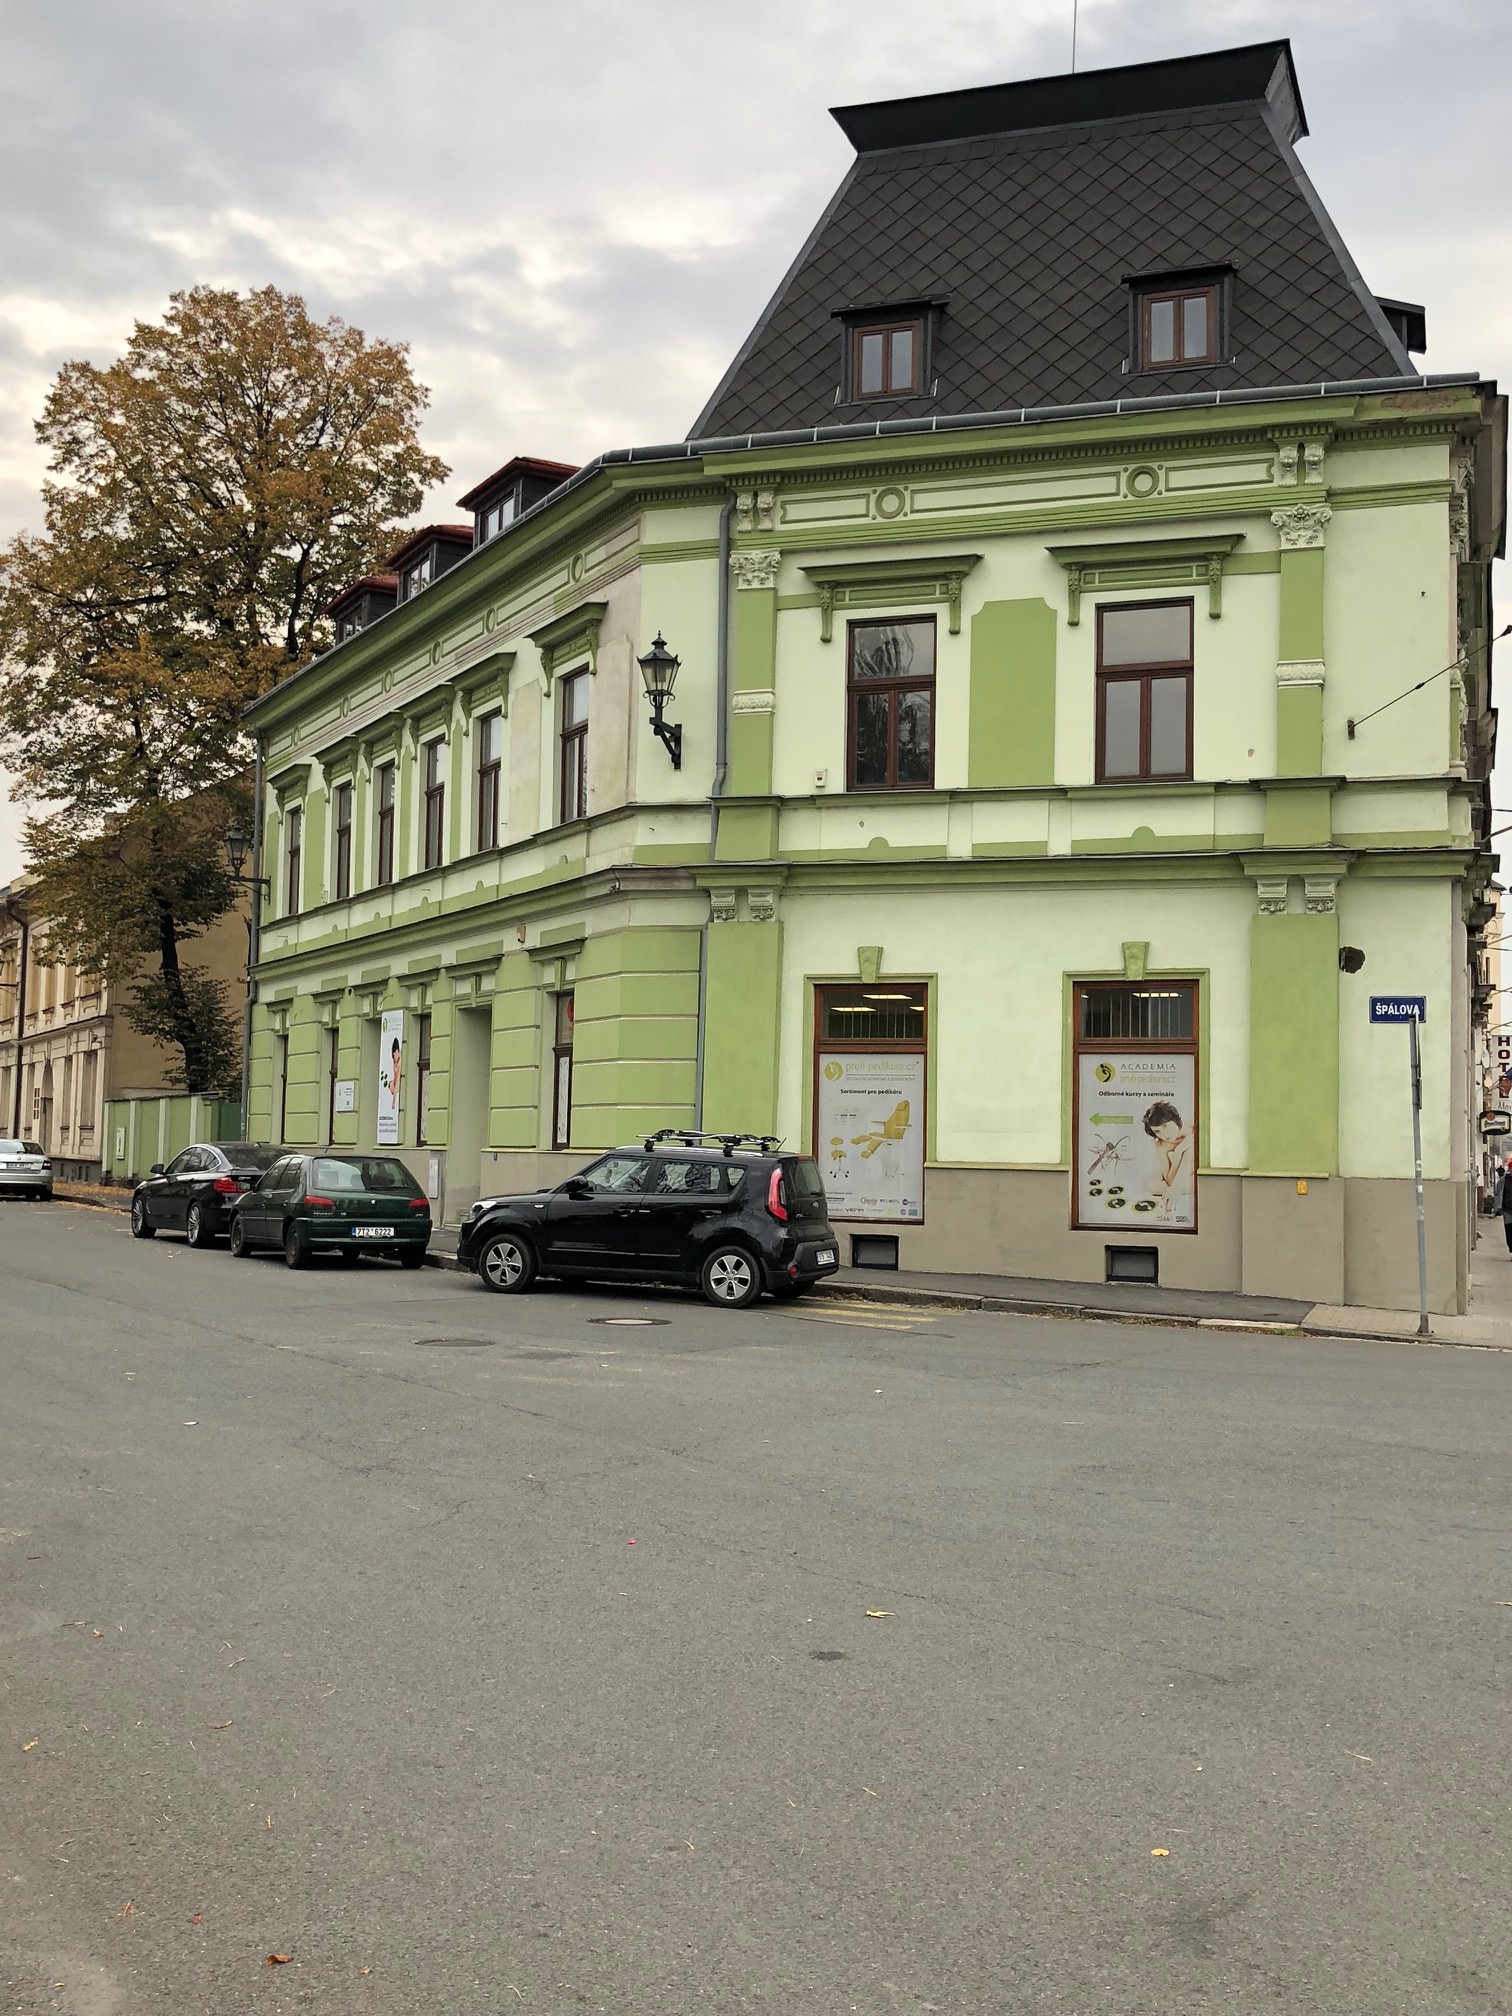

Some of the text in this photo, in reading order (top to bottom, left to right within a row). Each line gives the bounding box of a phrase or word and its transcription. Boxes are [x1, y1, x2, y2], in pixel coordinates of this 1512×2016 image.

[1375, 1002, 1421, 1015] ŠPÁLOVA
[357, 1228, 391, 1236] 7T2 6222
